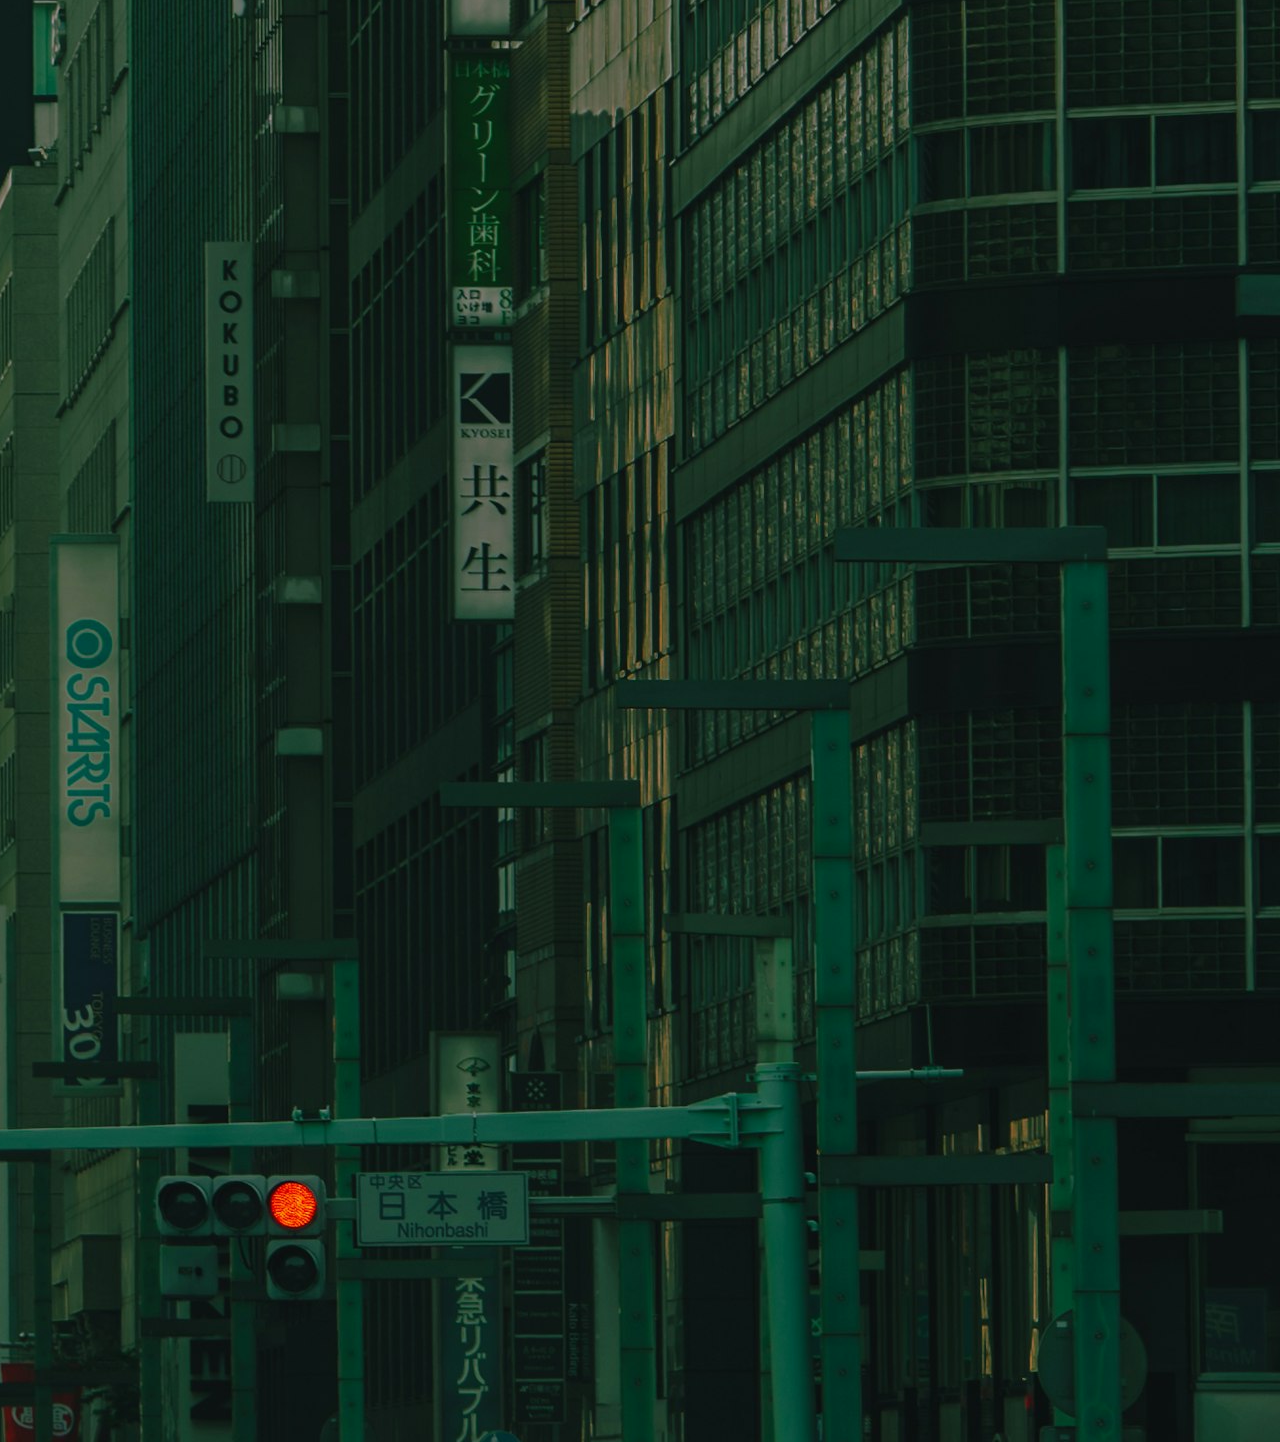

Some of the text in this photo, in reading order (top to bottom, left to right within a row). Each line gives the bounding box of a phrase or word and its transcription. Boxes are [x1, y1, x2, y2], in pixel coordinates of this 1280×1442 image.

[455, 59, 510, 79] 日本橋
[468, 84, 502, 283] グリーン歯科
[457, 290, 481, 300] 入口
[458, 315, 480, 325] ヨコ
[219, 260, 242, 439] KOKUBO
[460, 428, 510, 438] KYOSEI
[460, 465, 511, 591] 共生
[67, 674, 111, 827] STARTS
[90, 917, 100, 961] LOUNGE
[102, 917, 113, 965] BUSINESS
[369, 1175, 423, 1190] 中央区
[378, 1191, 508, 1220] 日本橋
[397, 1222, 489, 1239] Nihonbashi
